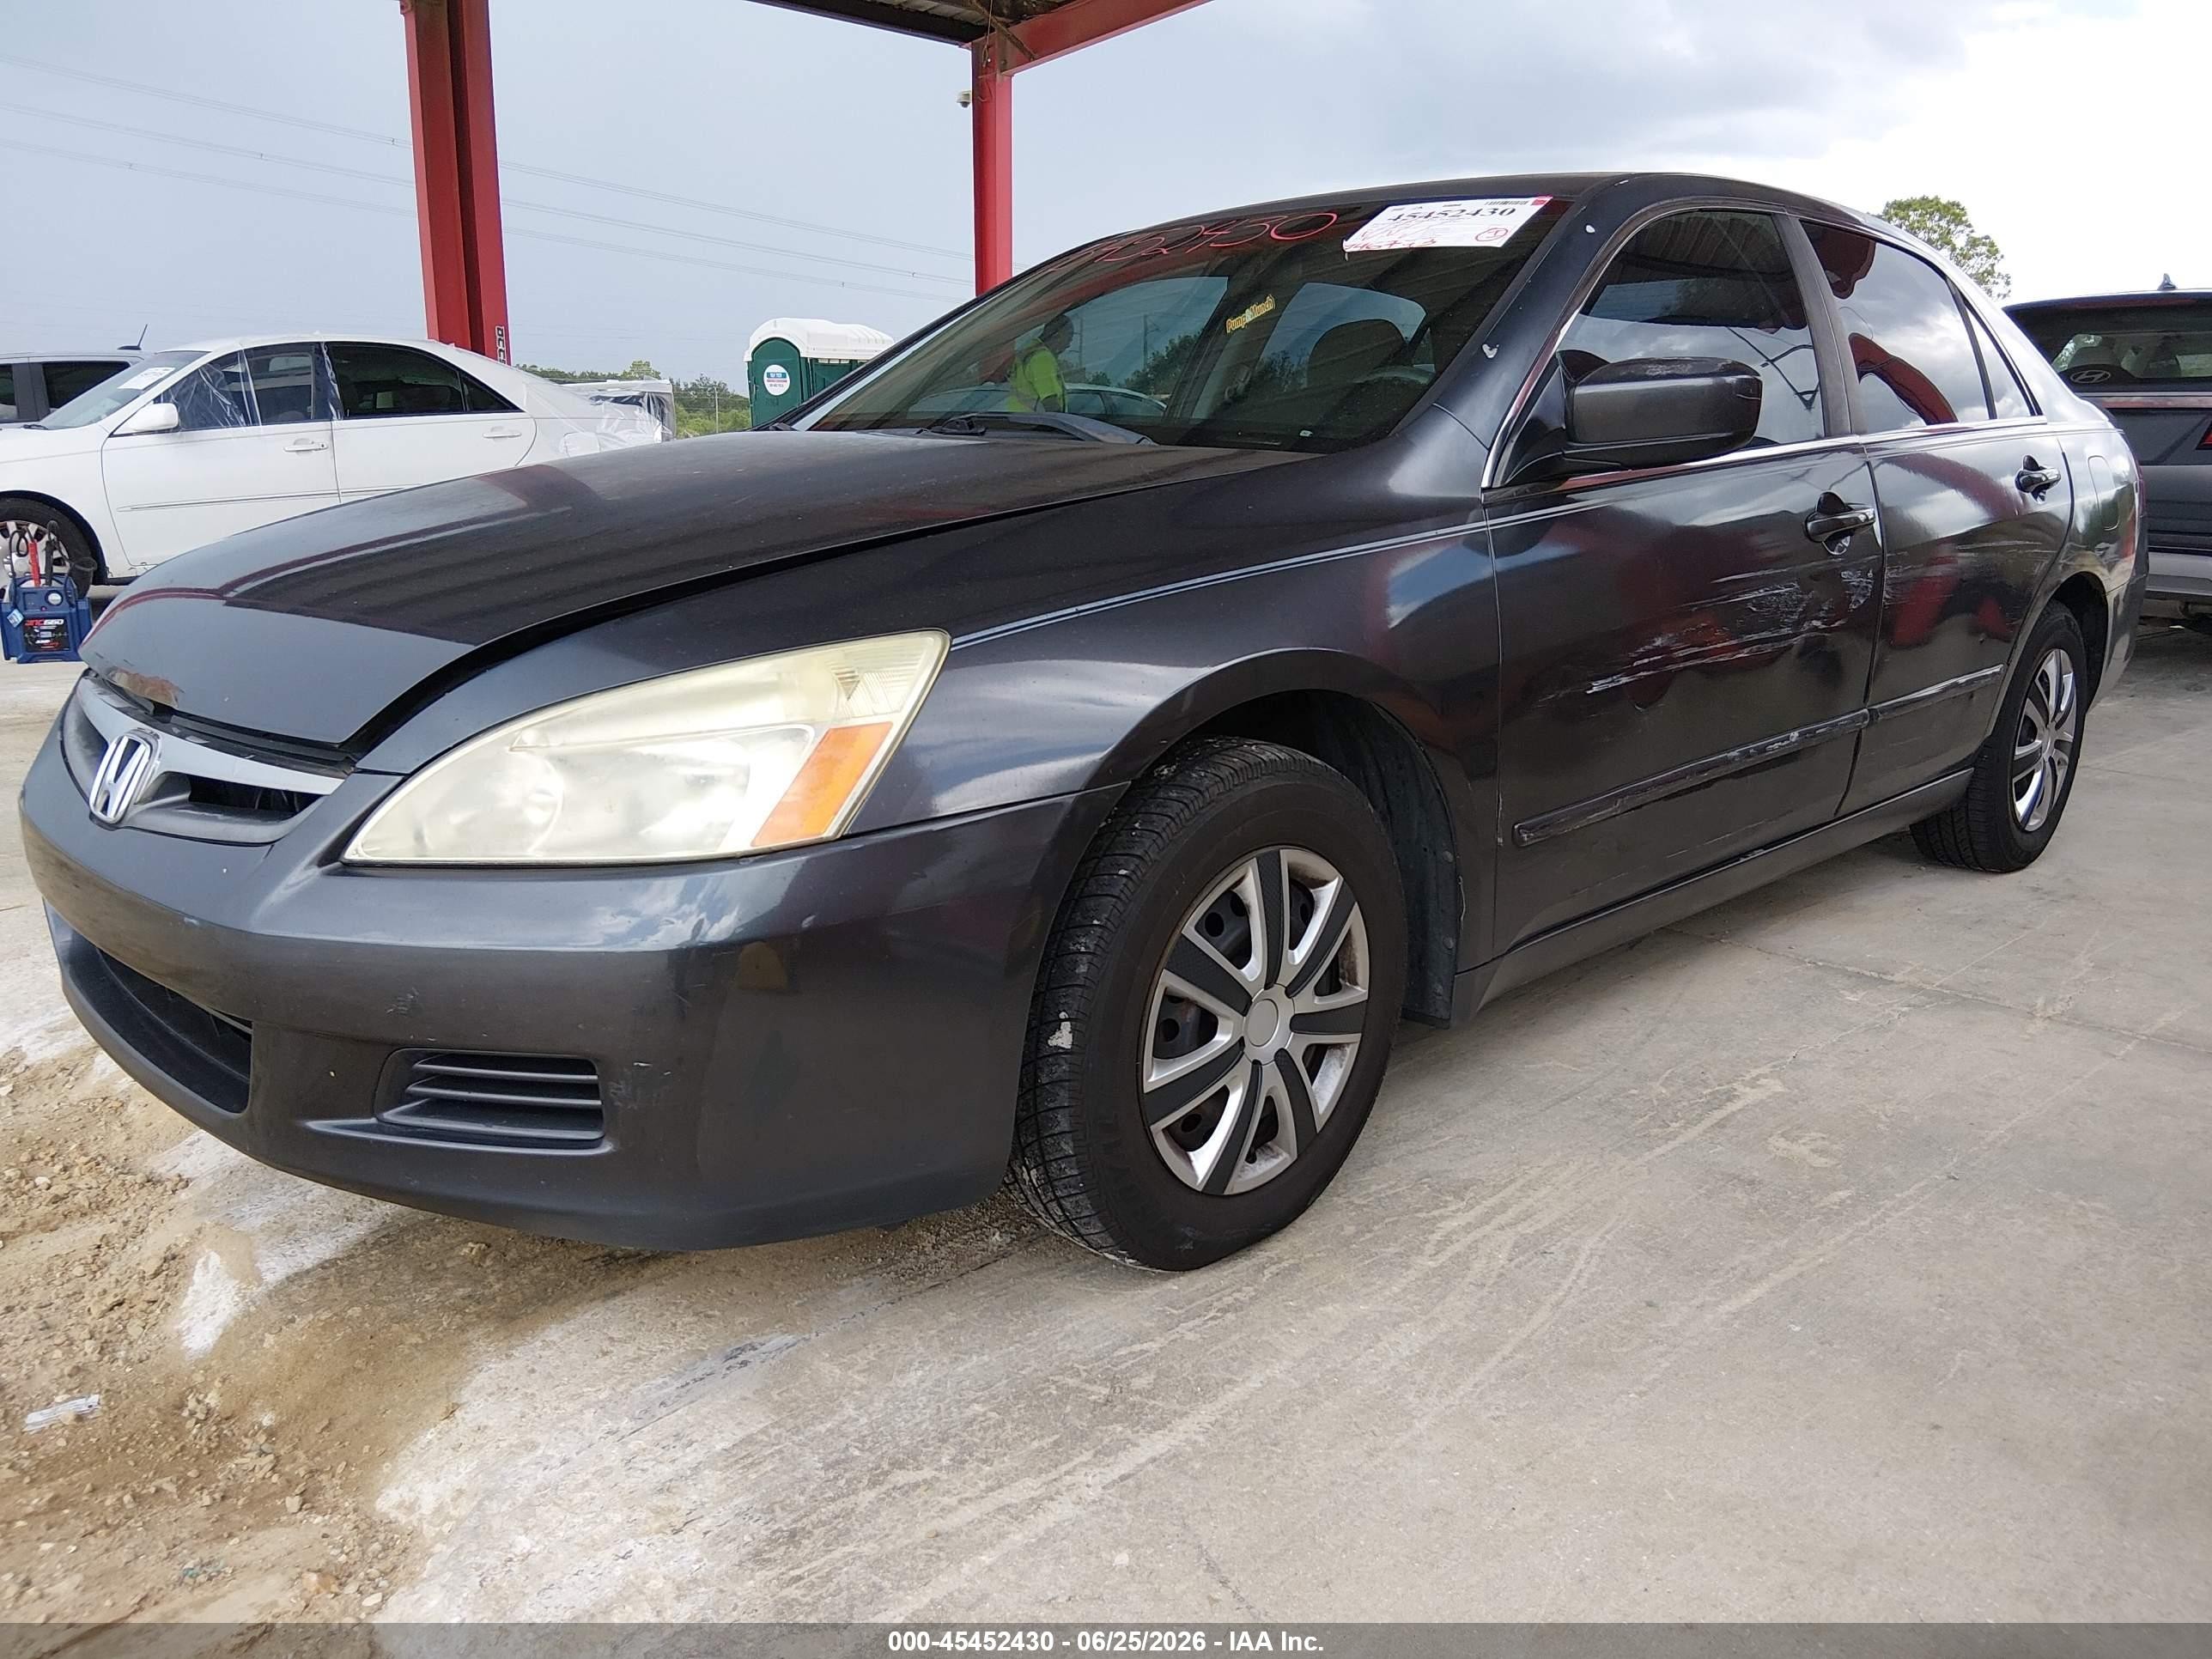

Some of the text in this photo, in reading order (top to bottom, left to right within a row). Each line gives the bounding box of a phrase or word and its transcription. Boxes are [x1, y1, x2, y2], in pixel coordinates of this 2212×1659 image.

[1387, 208, 1516, 222] 45452430
[1226, 313, 1246, 334] Pump
[1251, 295, 1274, 319] Munch
